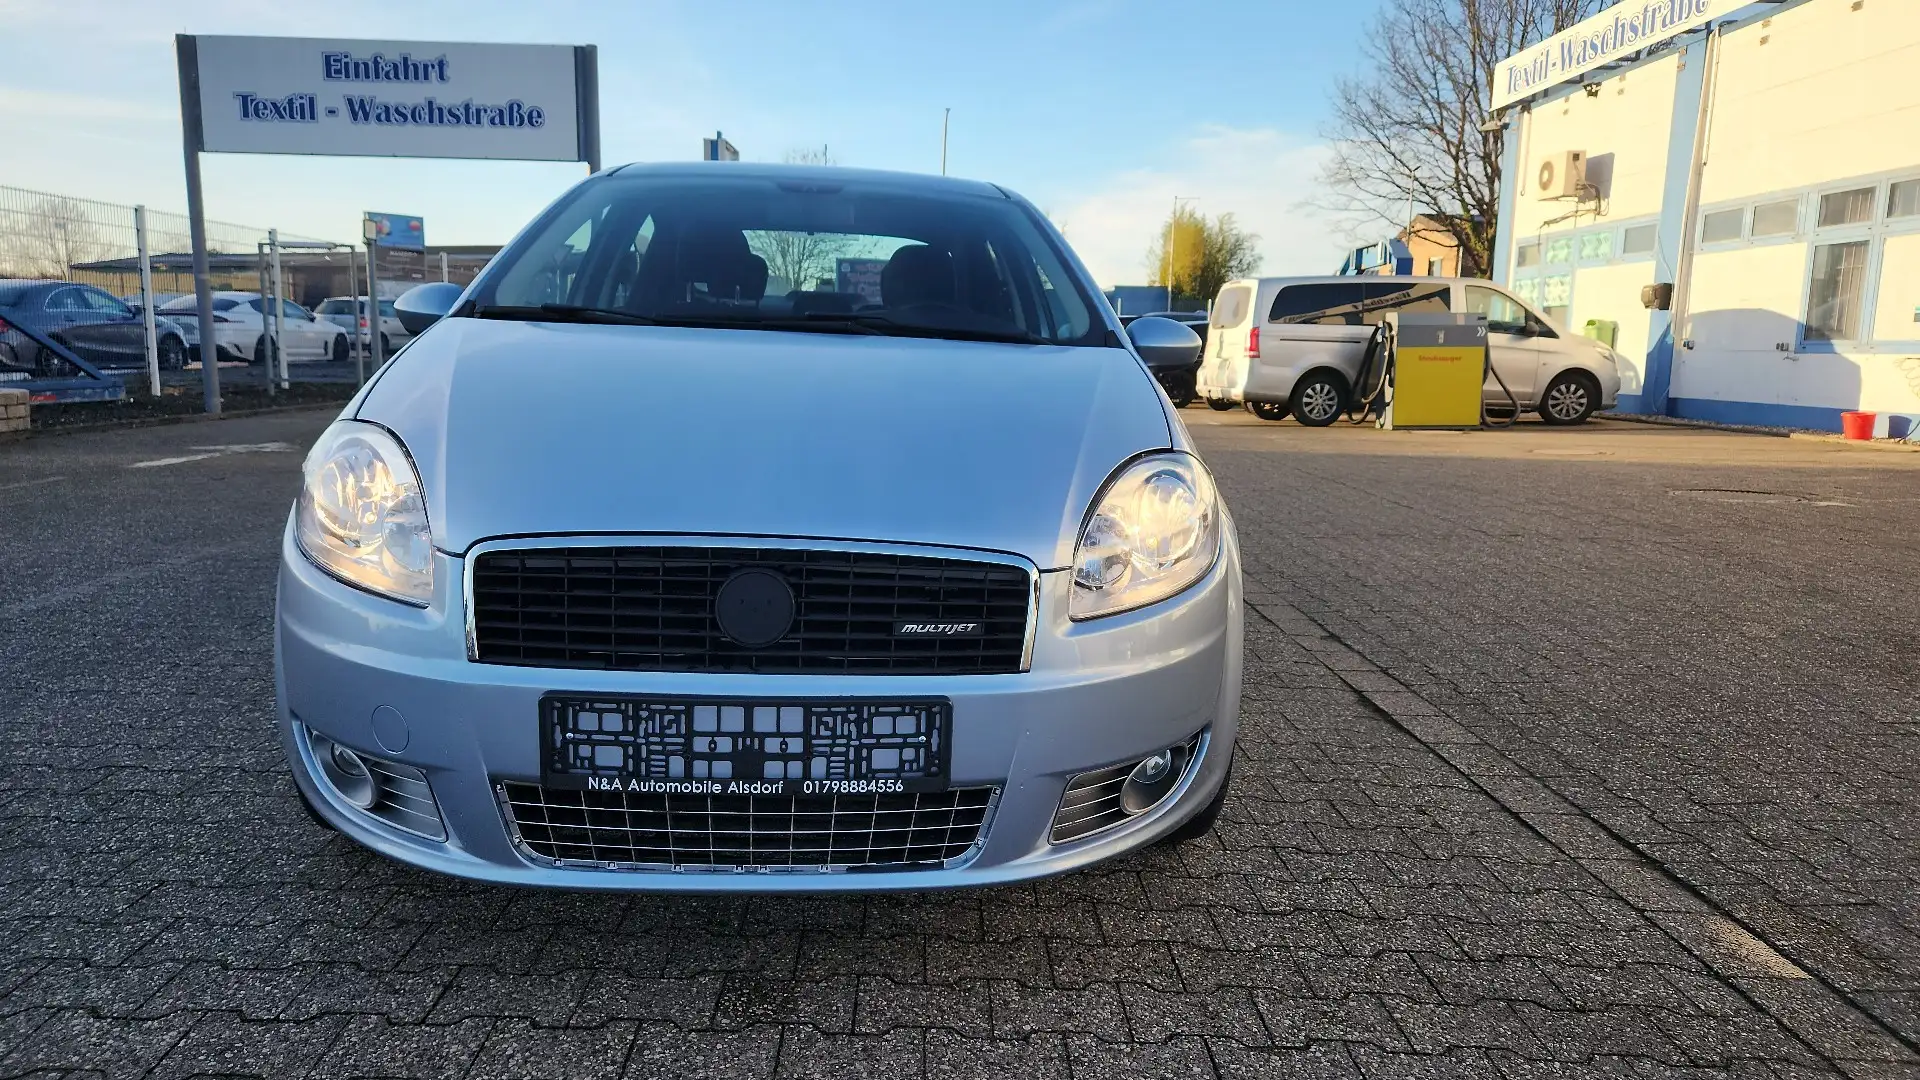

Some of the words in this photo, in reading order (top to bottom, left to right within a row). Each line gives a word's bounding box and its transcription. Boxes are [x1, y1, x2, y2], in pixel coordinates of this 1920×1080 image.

[323, 52, 449, 82] Einfahrt
[234, 92, 318, 122] Textil
[344, 97, 544, 128] Waschstraße
[901, 623, 977, 635] MULTIJET
[588, 776, 623, 791] N&A
[627, 778, 722, 793] Automobile
[727, 779, 784, 794] Alsdorf
[803, 779, 904, 794] 01798884556
